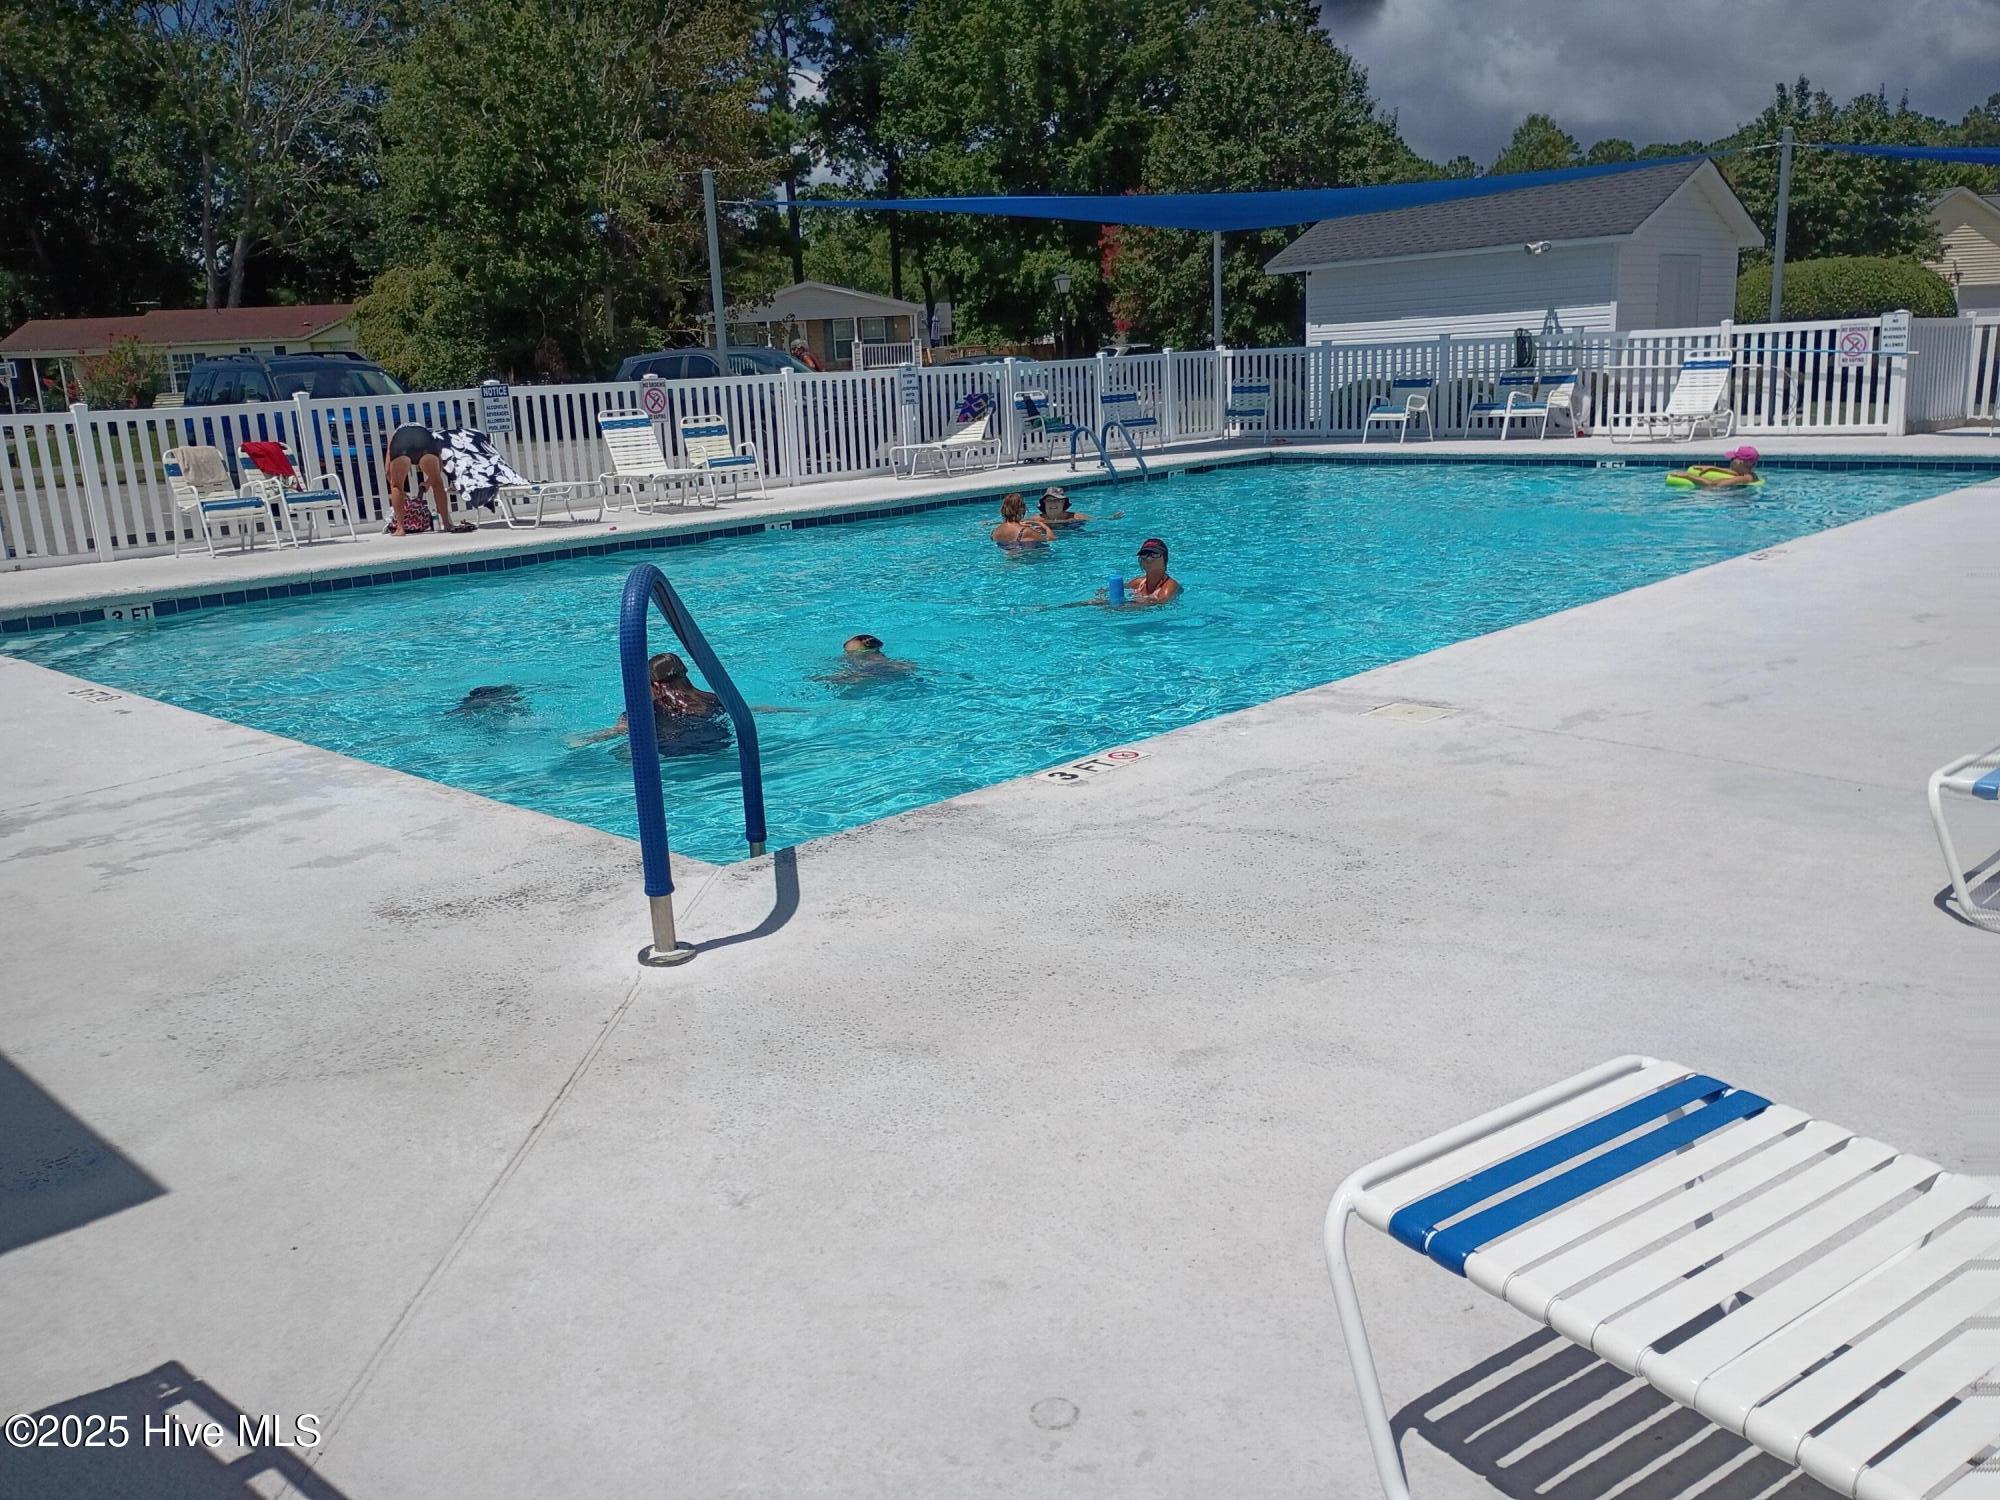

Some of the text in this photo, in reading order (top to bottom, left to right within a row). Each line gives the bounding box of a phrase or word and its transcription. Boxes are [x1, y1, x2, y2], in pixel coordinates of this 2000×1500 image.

[483, 386, 508, 397] NOTICE
[131, 605, 151, 621] FT
[1048, 759, 1116, 781] 3 FT
